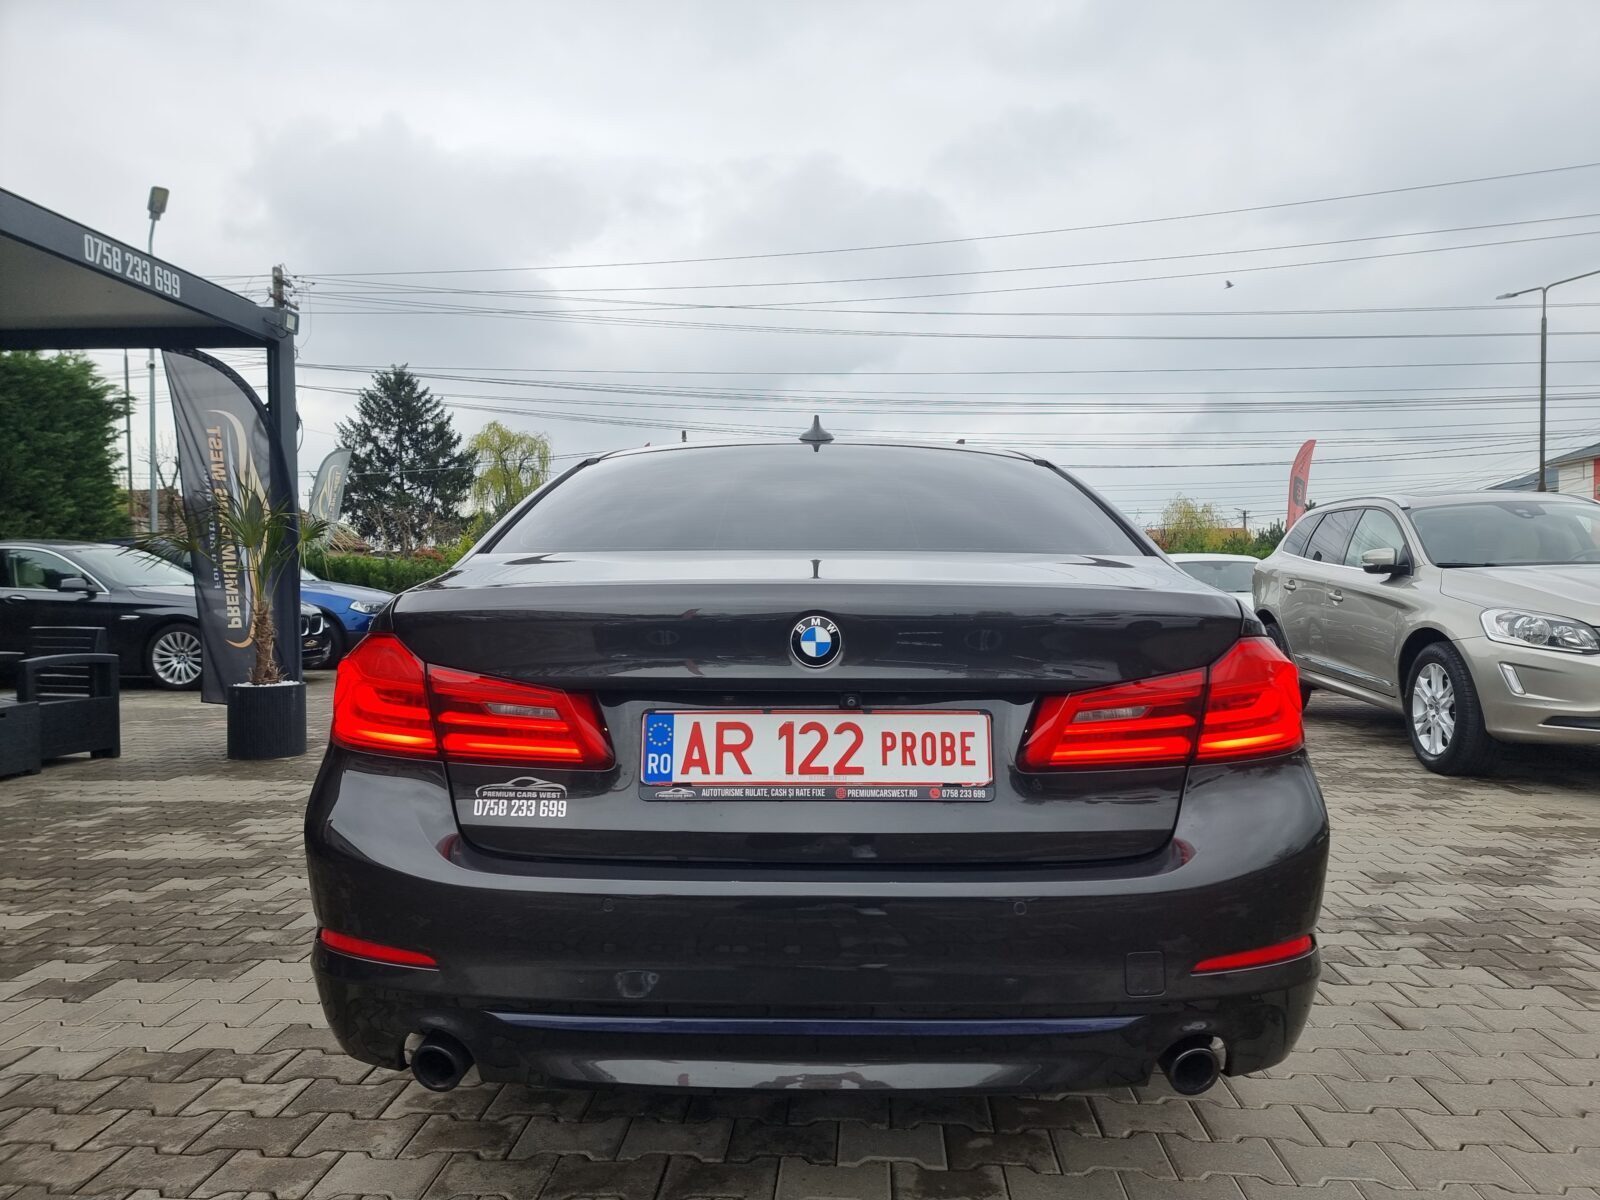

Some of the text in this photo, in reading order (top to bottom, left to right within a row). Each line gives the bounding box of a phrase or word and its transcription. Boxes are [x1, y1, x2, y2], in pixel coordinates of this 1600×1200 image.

[84, 233, 180, 298] 0758 233 699
[795, 617, 837, 634] BMW
[680, 721, 976, 775] AR 122 PROBE
[648, 753, 671, 774] RO
[539, 791, 562, 799] WEST
[702, 788, 742, 797] AUTOTURISME
[744, 788, 770, 798] RULATE,
[770, 788, 787, 797] CASH
[795, 788, 811, 797] RATE
[811, 788, 826, 797] FIXE
[847, 789, 918, 798] PREMIUMCARSWEST.RO
[941, 789, 986, 798] 0758 233 699
[473, 799, 567, 817] 0758 233 699
